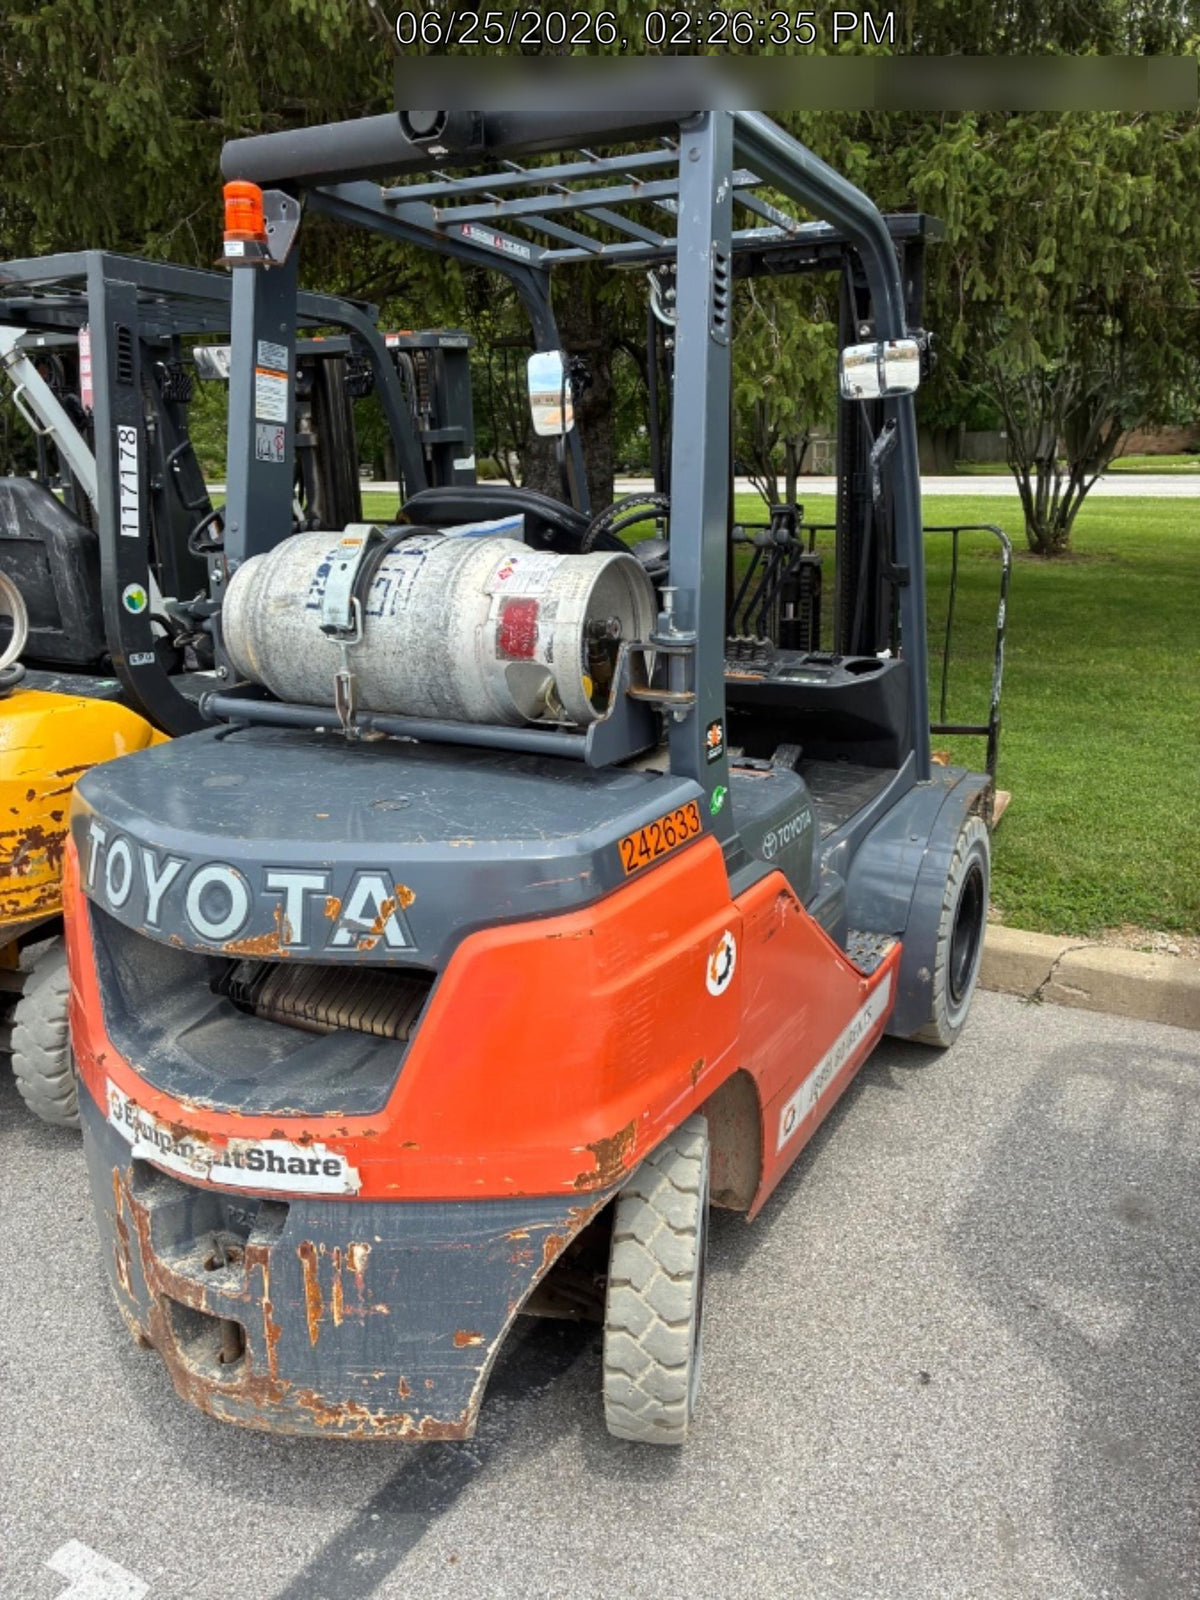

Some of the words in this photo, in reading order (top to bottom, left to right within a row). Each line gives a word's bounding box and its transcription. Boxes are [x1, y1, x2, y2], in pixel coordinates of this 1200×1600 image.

[119, 428, 138, 533] 117178
[622, 803, 700, 872] 242633
[778, 809, 811, 847] TOYOTA
[86, 822, 407, 948] TOYOTA
